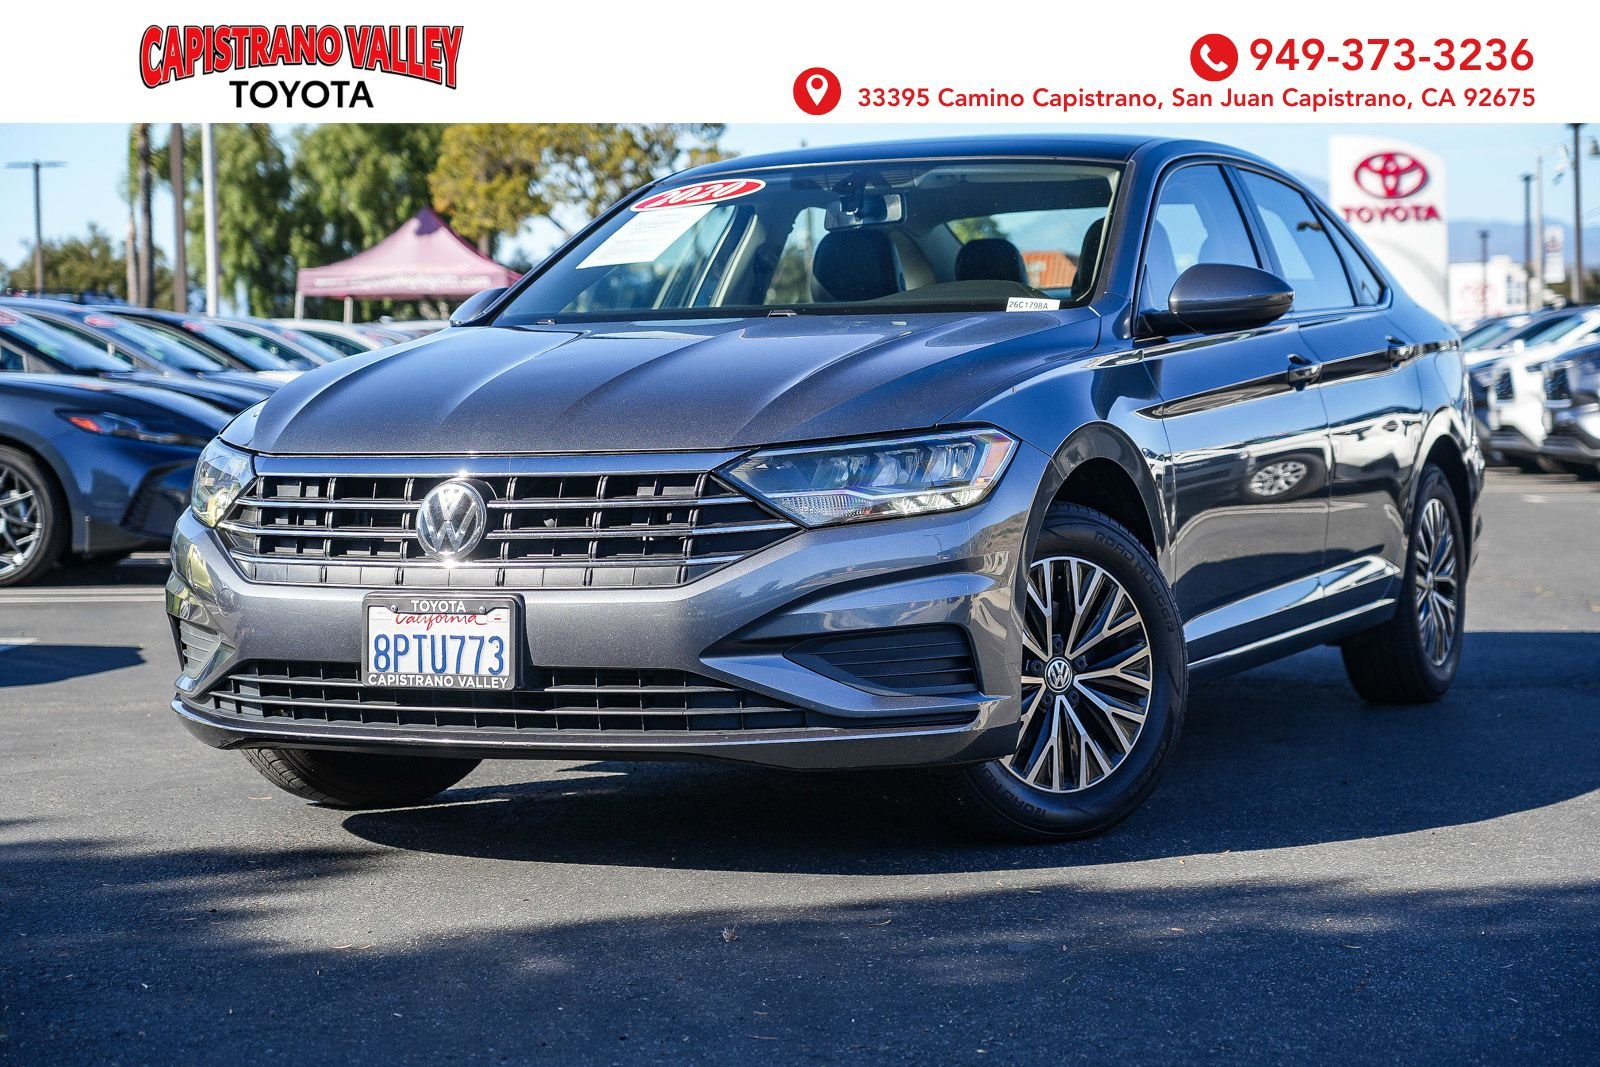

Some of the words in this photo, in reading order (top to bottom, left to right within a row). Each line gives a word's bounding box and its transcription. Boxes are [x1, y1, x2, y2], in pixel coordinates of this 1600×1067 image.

[642, 181, 748, 208] 2020
[1341, 204, 1442, 224] TOYOTA
[1008, 301, 1049, 309] 26C1798A
[411, 600, 467, 613] TOYOTA
[373, 633, 504, 676] 8PTU773
[368, 674, 454, 688] CAPISTRANO
[458, 676, 508, 689] VALLEY
